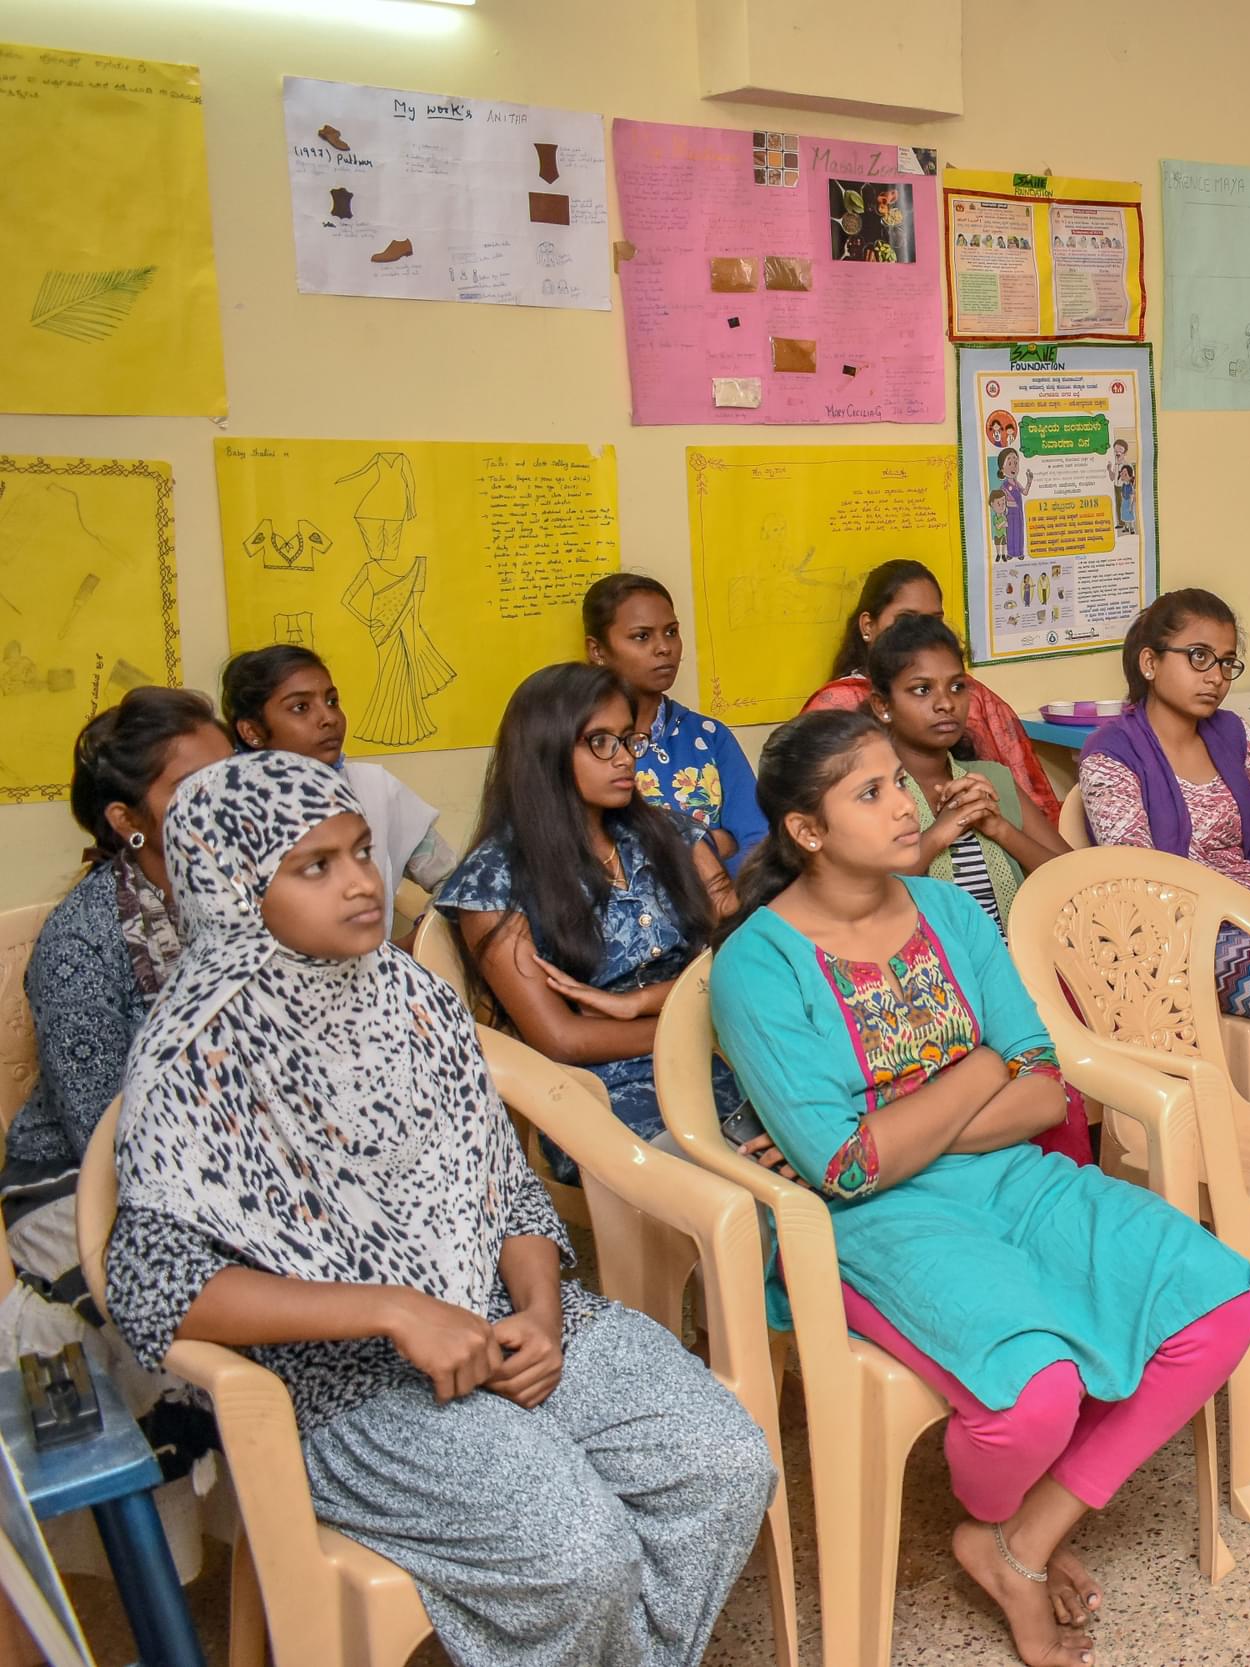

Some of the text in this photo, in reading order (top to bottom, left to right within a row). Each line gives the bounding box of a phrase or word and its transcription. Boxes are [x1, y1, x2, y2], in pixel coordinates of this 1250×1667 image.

[394, 99, 416, 121] My
[1011, 362, 1065, 371] FOUNDATION
[1039, 502, 1049, 511] 12
[1079, 499, 1099, 509] 2018
